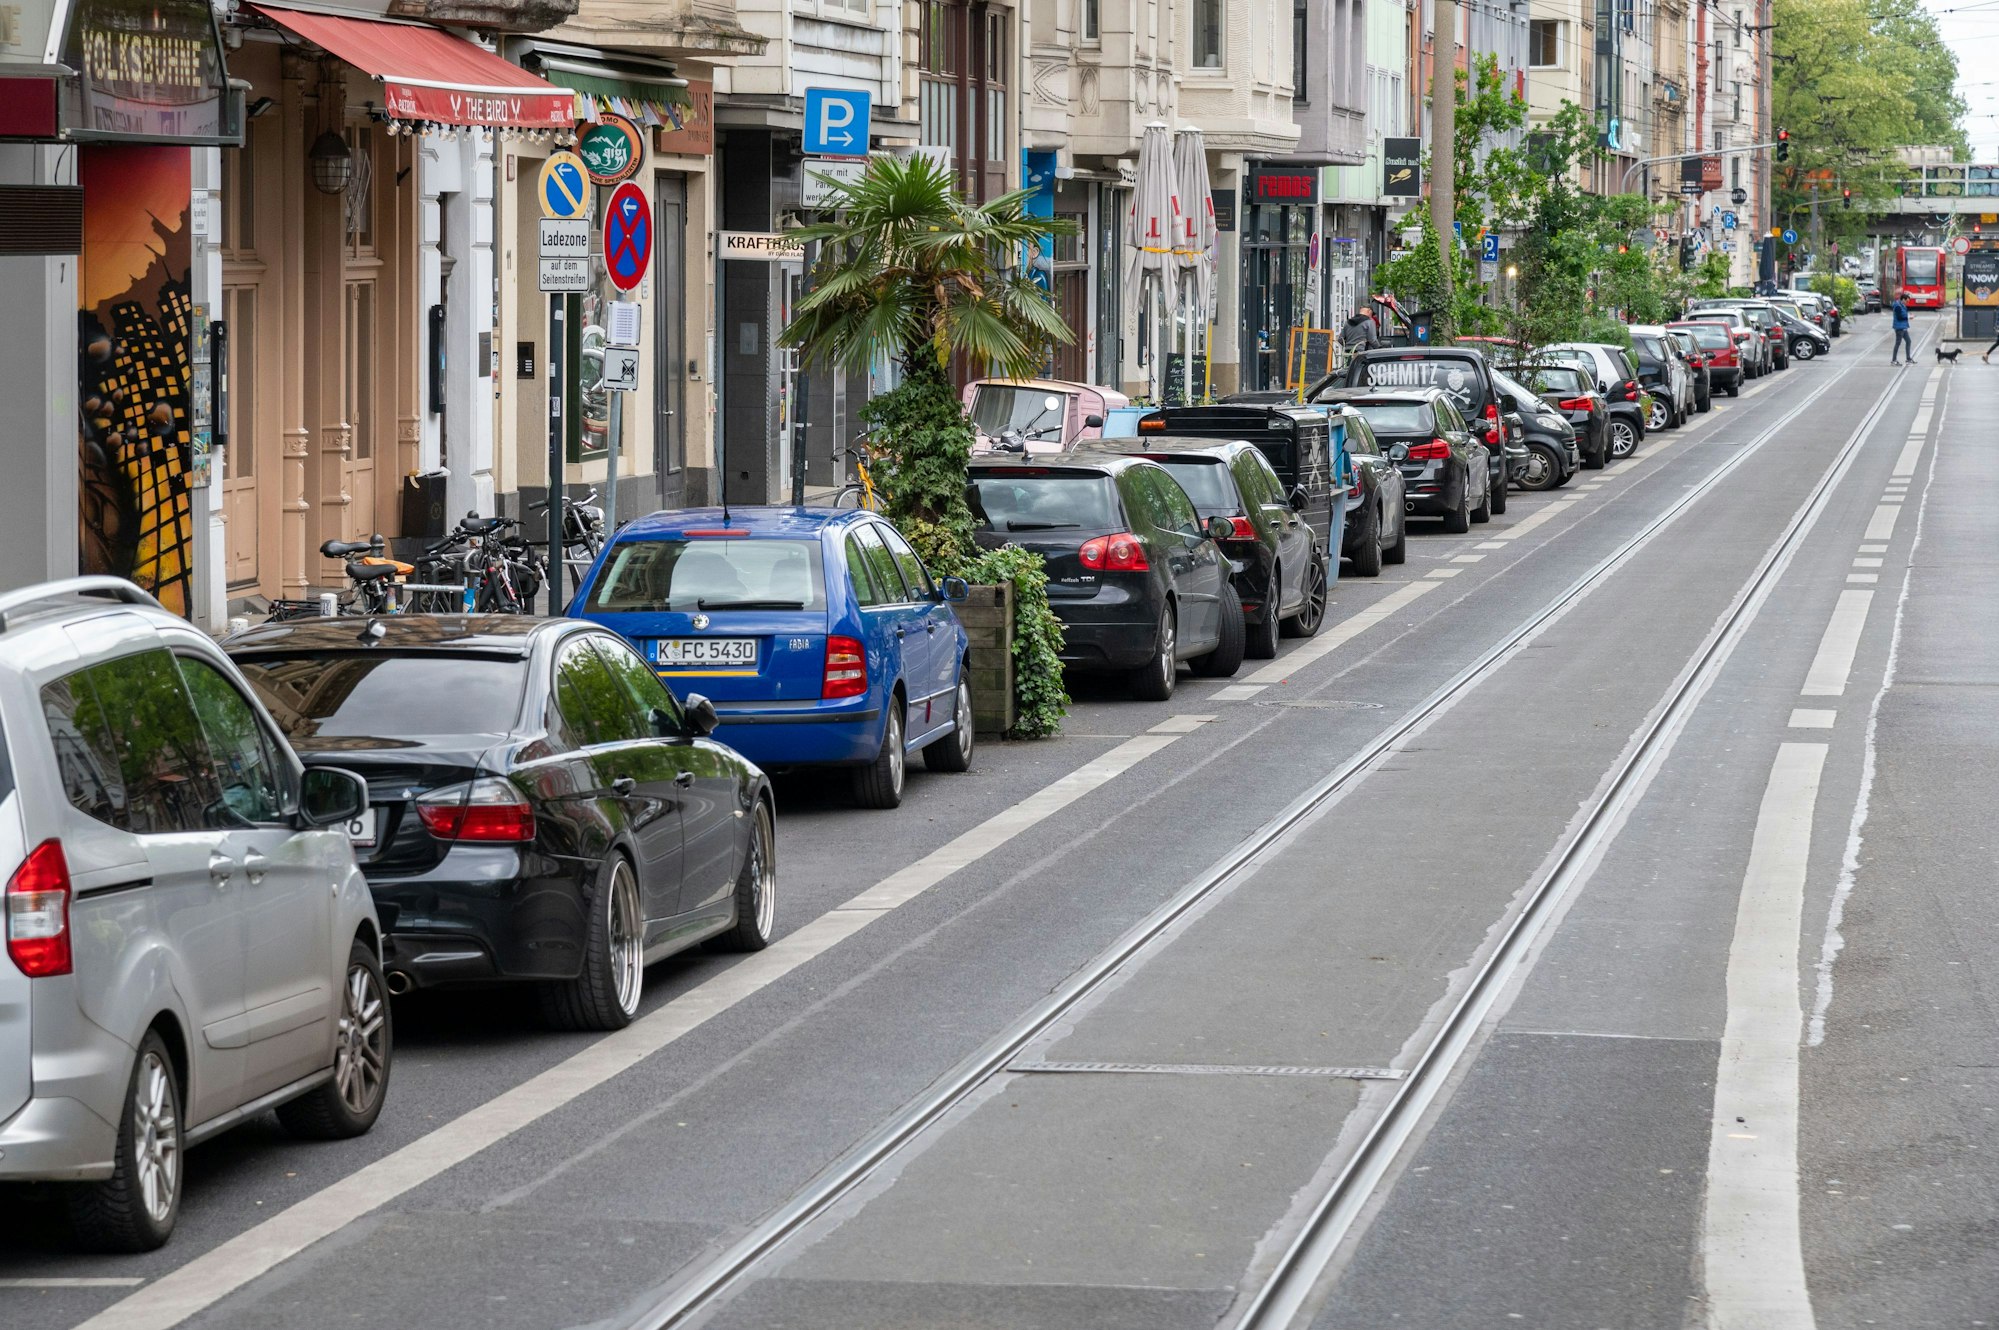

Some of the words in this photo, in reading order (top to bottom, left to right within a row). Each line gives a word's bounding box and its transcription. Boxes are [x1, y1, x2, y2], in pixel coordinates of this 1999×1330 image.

[465, 97, 484, 120] THE
[485, 99, 508, 122] BIRD
[819, 97, 855, 145] P
[821, 167, 834, 176] nur
[836, 166, 848, 177] mit
[815, 180, 853, 190] Parkin
[542, 230, 587, 247] Ladezone
[551, 260, 562, 271] auf
[564, 260, 578, 271] dem
[542, 273, 586, 286] Seitenstreifen
[1367, 363, 1438, 386] SCHMITZ
[659, 642, 668, 659] K
[682, 642, 704, 659] FC
[709, 642, 754, 659] 5430
[789, 638, 810, 650] FABIA
